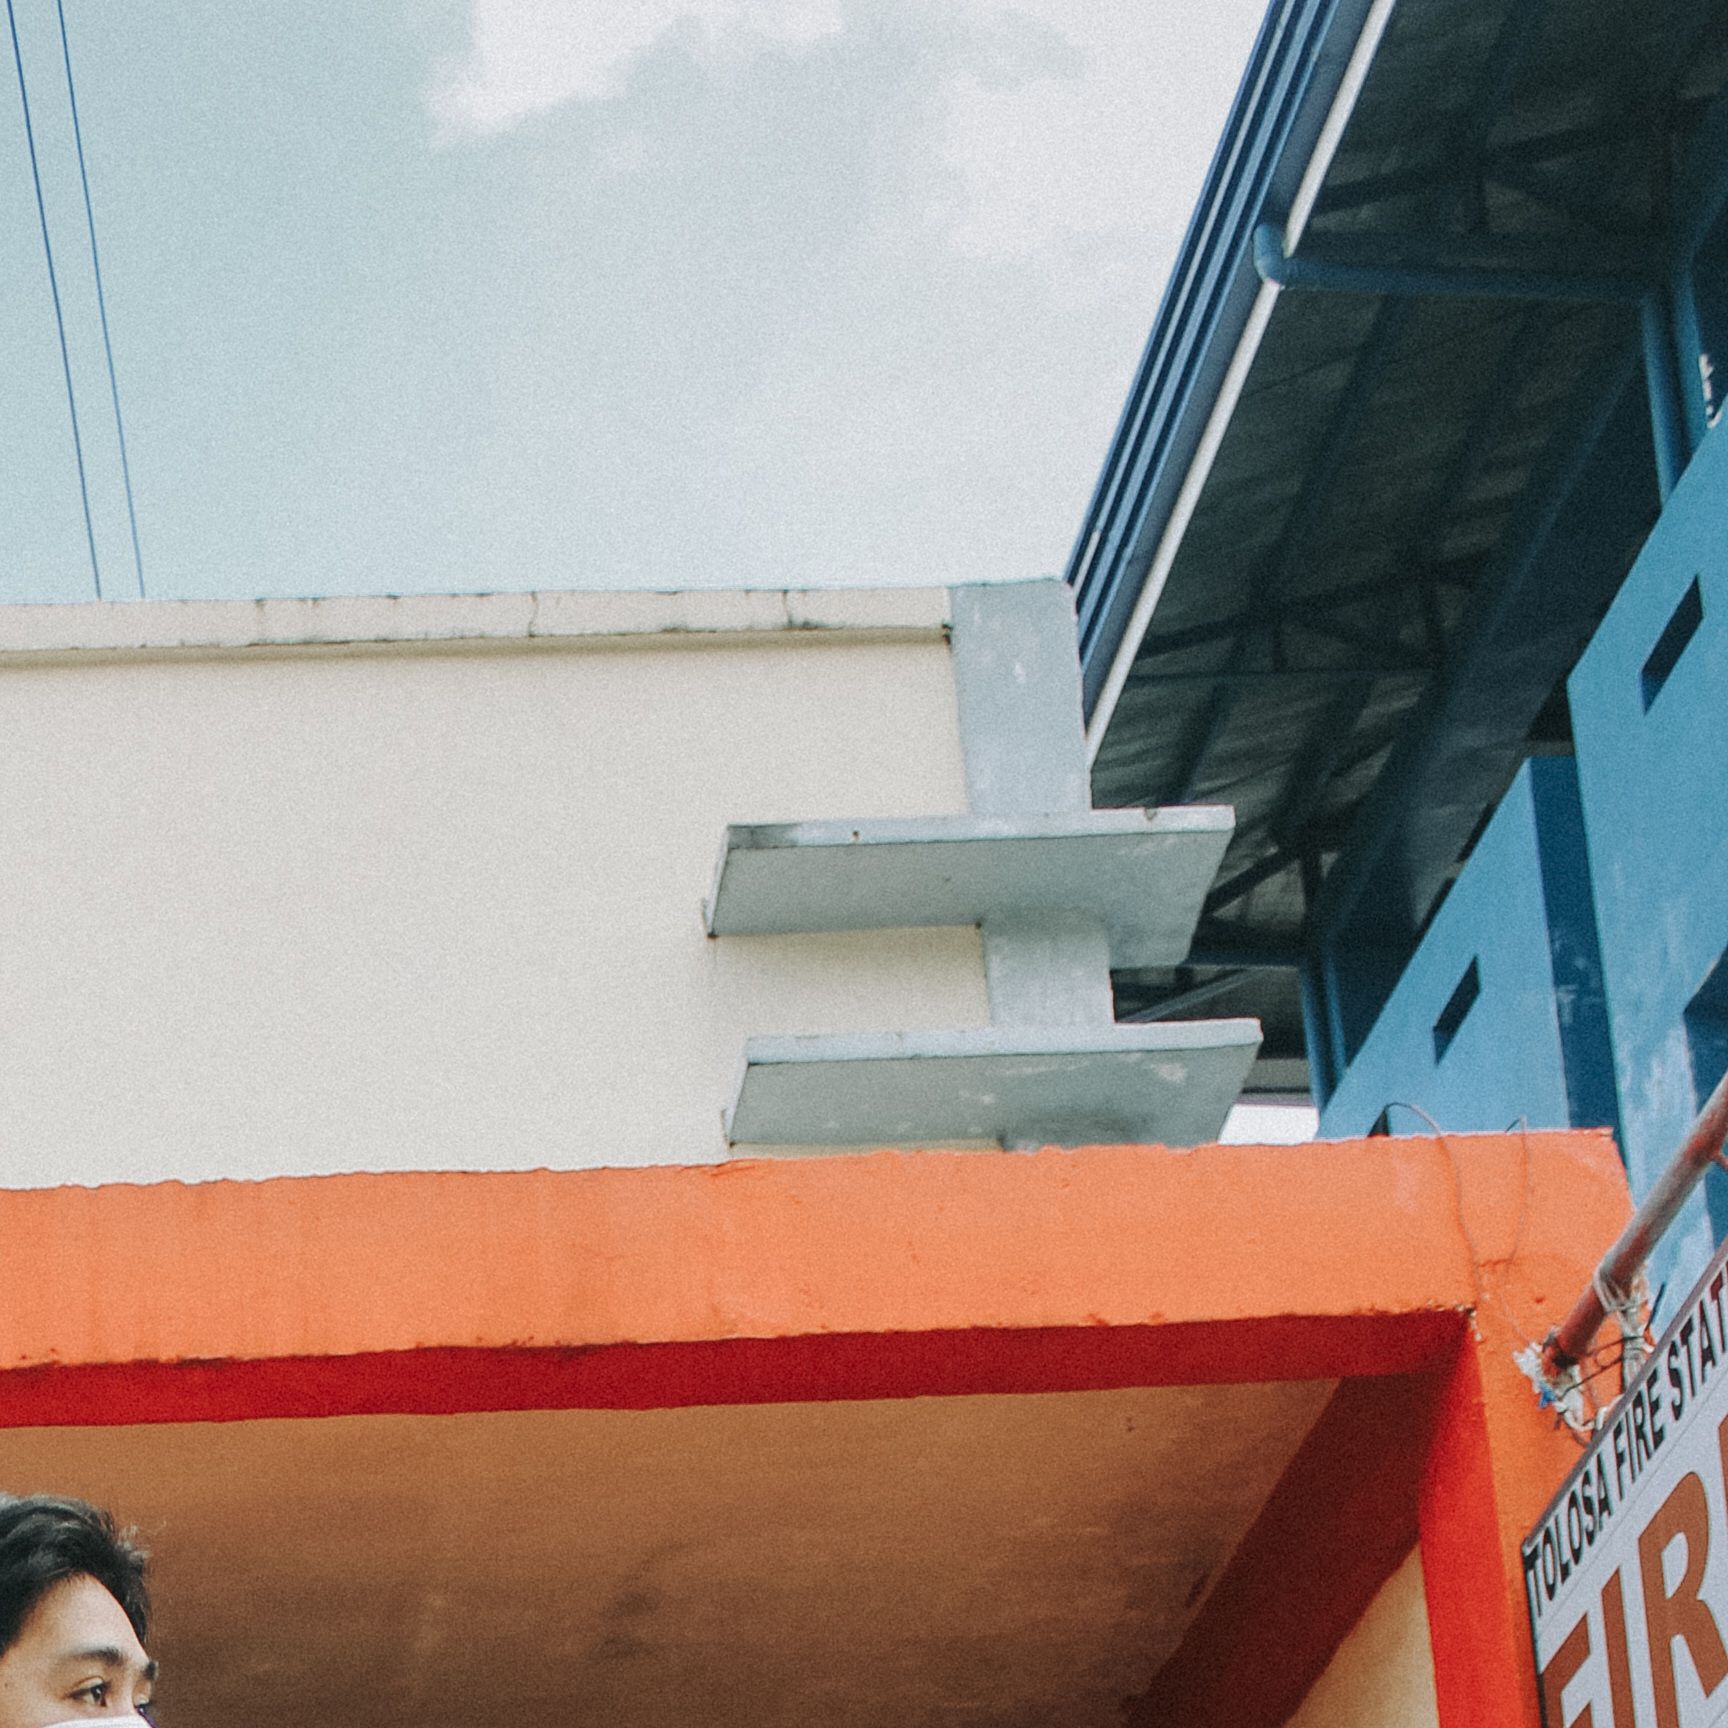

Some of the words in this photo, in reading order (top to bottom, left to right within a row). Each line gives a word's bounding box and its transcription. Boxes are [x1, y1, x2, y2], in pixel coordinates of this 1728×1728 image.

[1523, 1450, 1613, 1618] TOLOSA
[1613, 1368, 1665, 1501] FIRE
[1668, 1261, 1728, 1422] STAT
